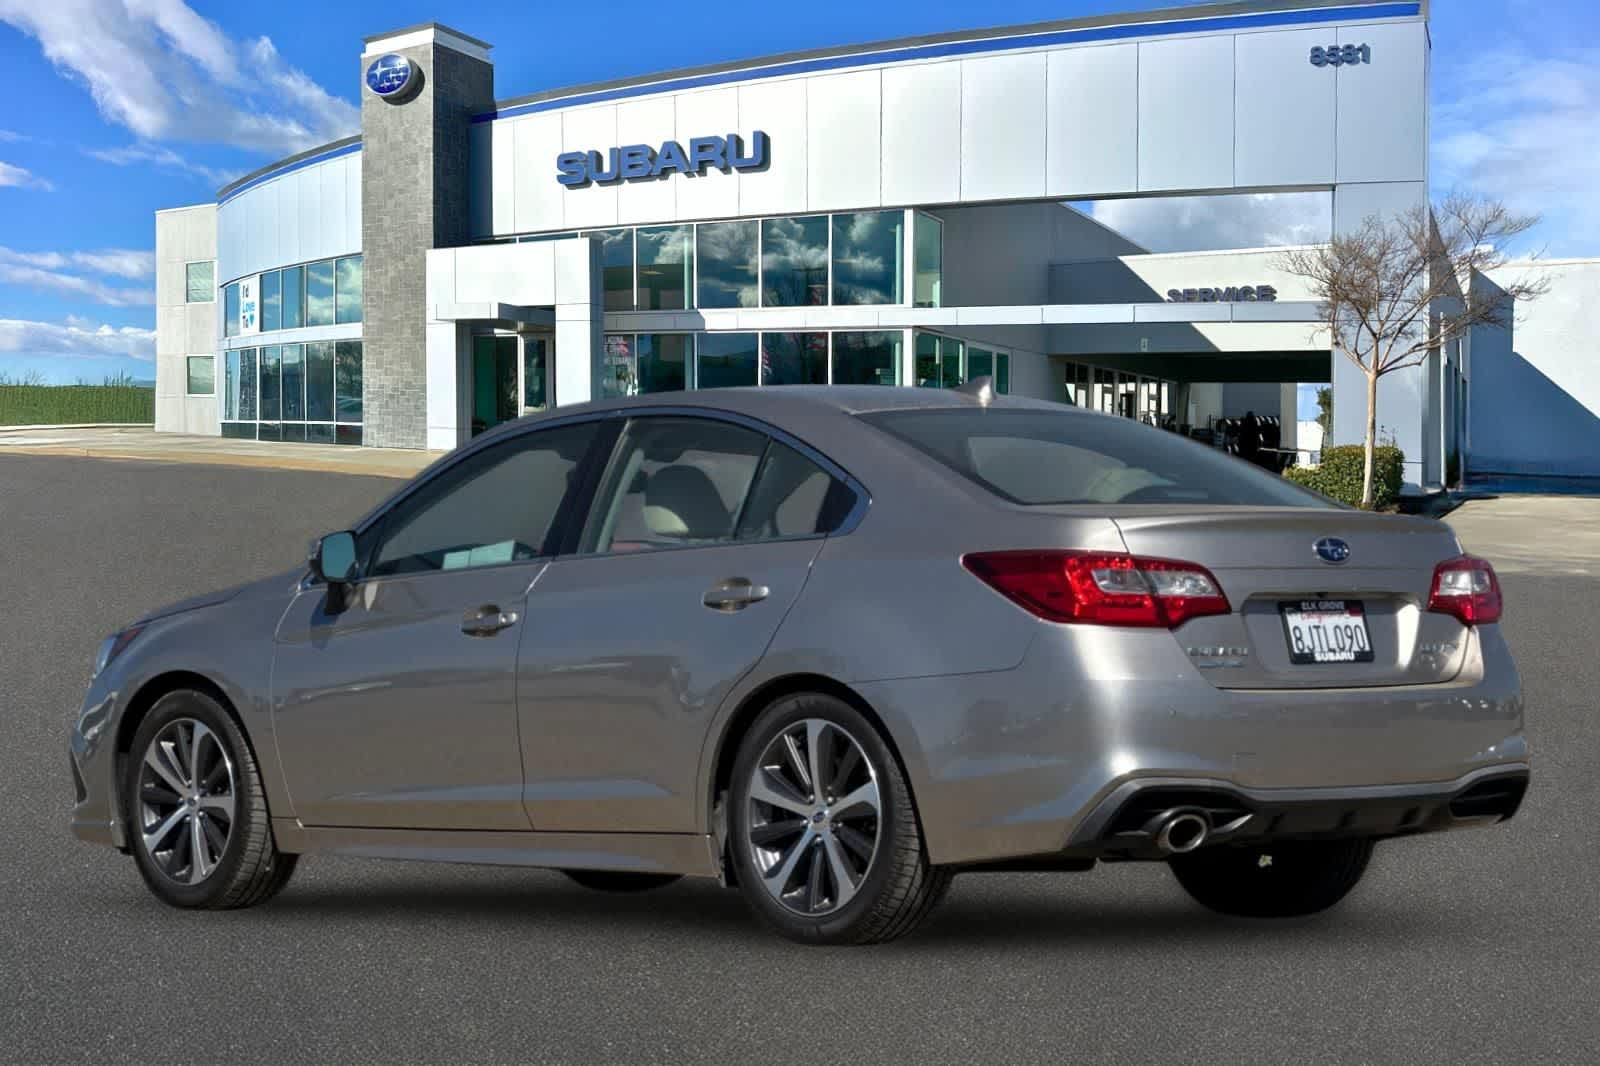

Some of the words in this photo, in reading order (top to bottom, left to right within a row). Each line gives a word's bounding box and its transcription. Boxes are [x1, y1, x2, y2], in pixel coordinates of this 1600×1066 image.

[557, 130, 771, 190] SUBARU
[1167, 285, 1277, 302] SERVICE
[1301, 601, 1317, 610] ELK
[1318, 601, 1345, 610] GROVE
[1292, 624, 1366, 653] 8JTL090
[1314, 650, 1355, 662] SUBARU
